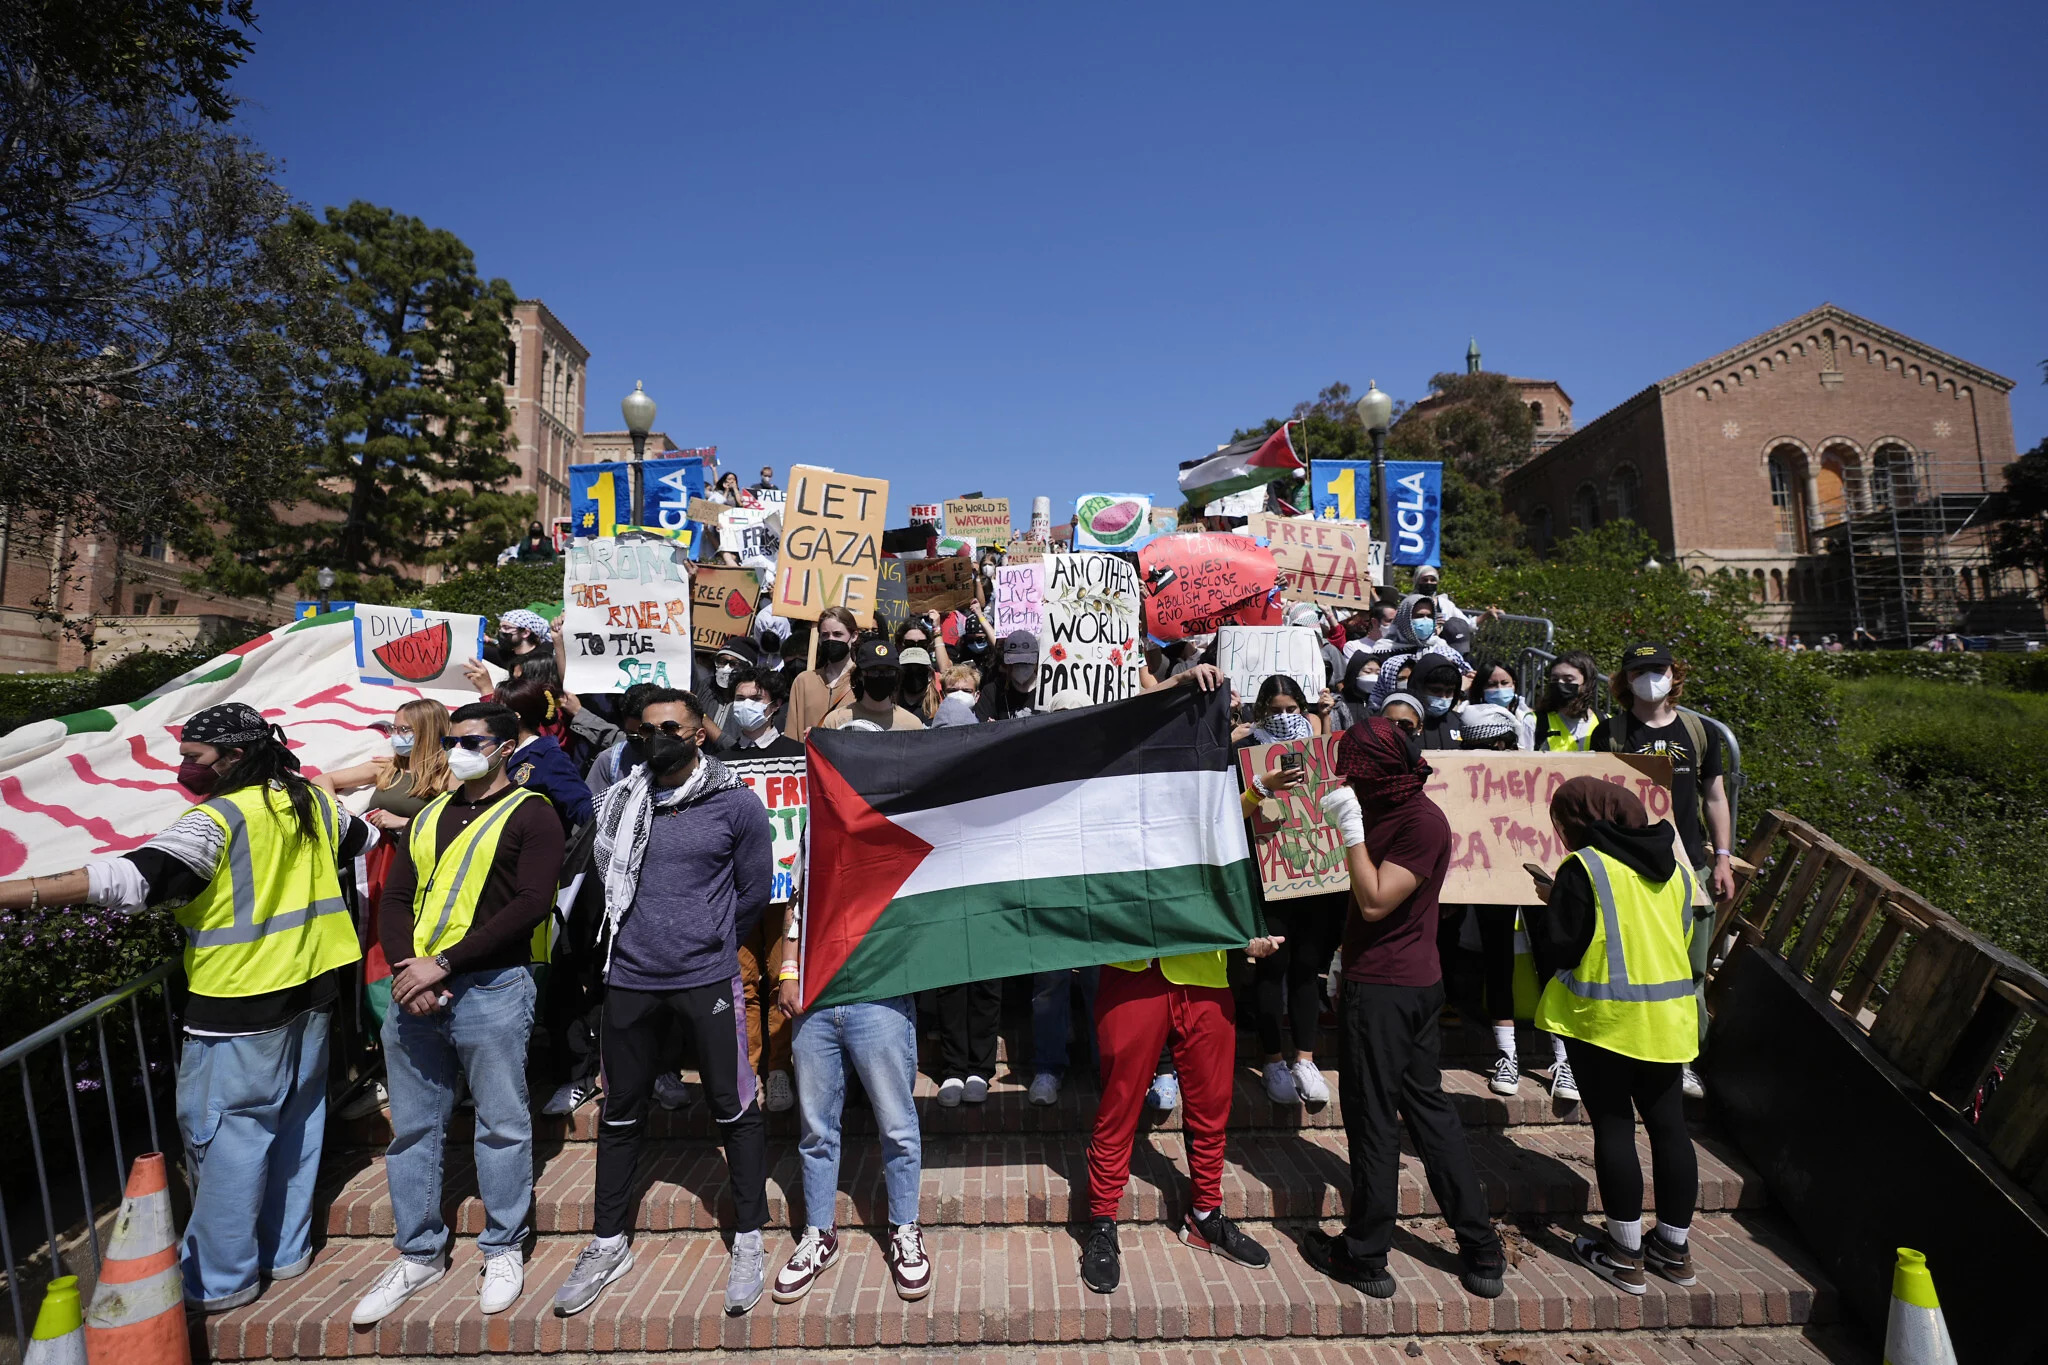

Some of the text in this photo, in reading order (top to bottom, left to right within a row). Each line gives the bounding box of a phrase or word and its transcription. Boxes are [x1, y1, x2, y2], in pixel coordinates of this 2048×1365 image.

[582, 471, 617, 538] #1
[658, 468, 687, 531] CLA
[794, 476, 877, 522] LET
[946, 502, 1008, 514] The WORLD IS
[1324, 468, 1356, 520] #1
[911, 506, 937, 517] FREE
[954, 514, 1010, 527] WATCHING
[1079, 496, 1113, 529] FREE
[1397, 471, 1425, 553] UCLA
[784, 525, 879, 570] GAZA
[1265, 520, 1333, 549] FREE
[569, 541, 684, 585] FROM
[953, 562, 965, 571] IS
[998, 568, 1034, 590] Long
[1051, 555, 1137, 597] ANOTHER
[1178, 557, 1231, 579] DIVEST
[1269, 548, 1362, 600] GAZA
[571, 583, 611, 609] THE
[780, 566, 869, 616] LIVE
[998, 584, 1037, 603] Live
[1156, 582, 1261, 610] ABOLISH POLICING
[1180, 572, 1237, 592] DISCLOSE
[371, 615, 451, 641] DIVEST
[605, 598, 686, 636] RIVER
[1049, 612, 1130, 645] WORLD
[1157, 607, 1183, 625] END
[1190, 602, 1213, 618] THE
[385, 640, 445, 665] NOW!
[573, 632, 656, 656] TO THE
[1091, 647, 1103, 659] IS
[1220, 629, 1319, 672] PROTECT
[614, 657, 671, 691] SEA
[1038, 662, 1136, 706] POSSIBLE
[1463, 762, 1543, 810] THEY
[1635, 778, 1670, 817] TO
